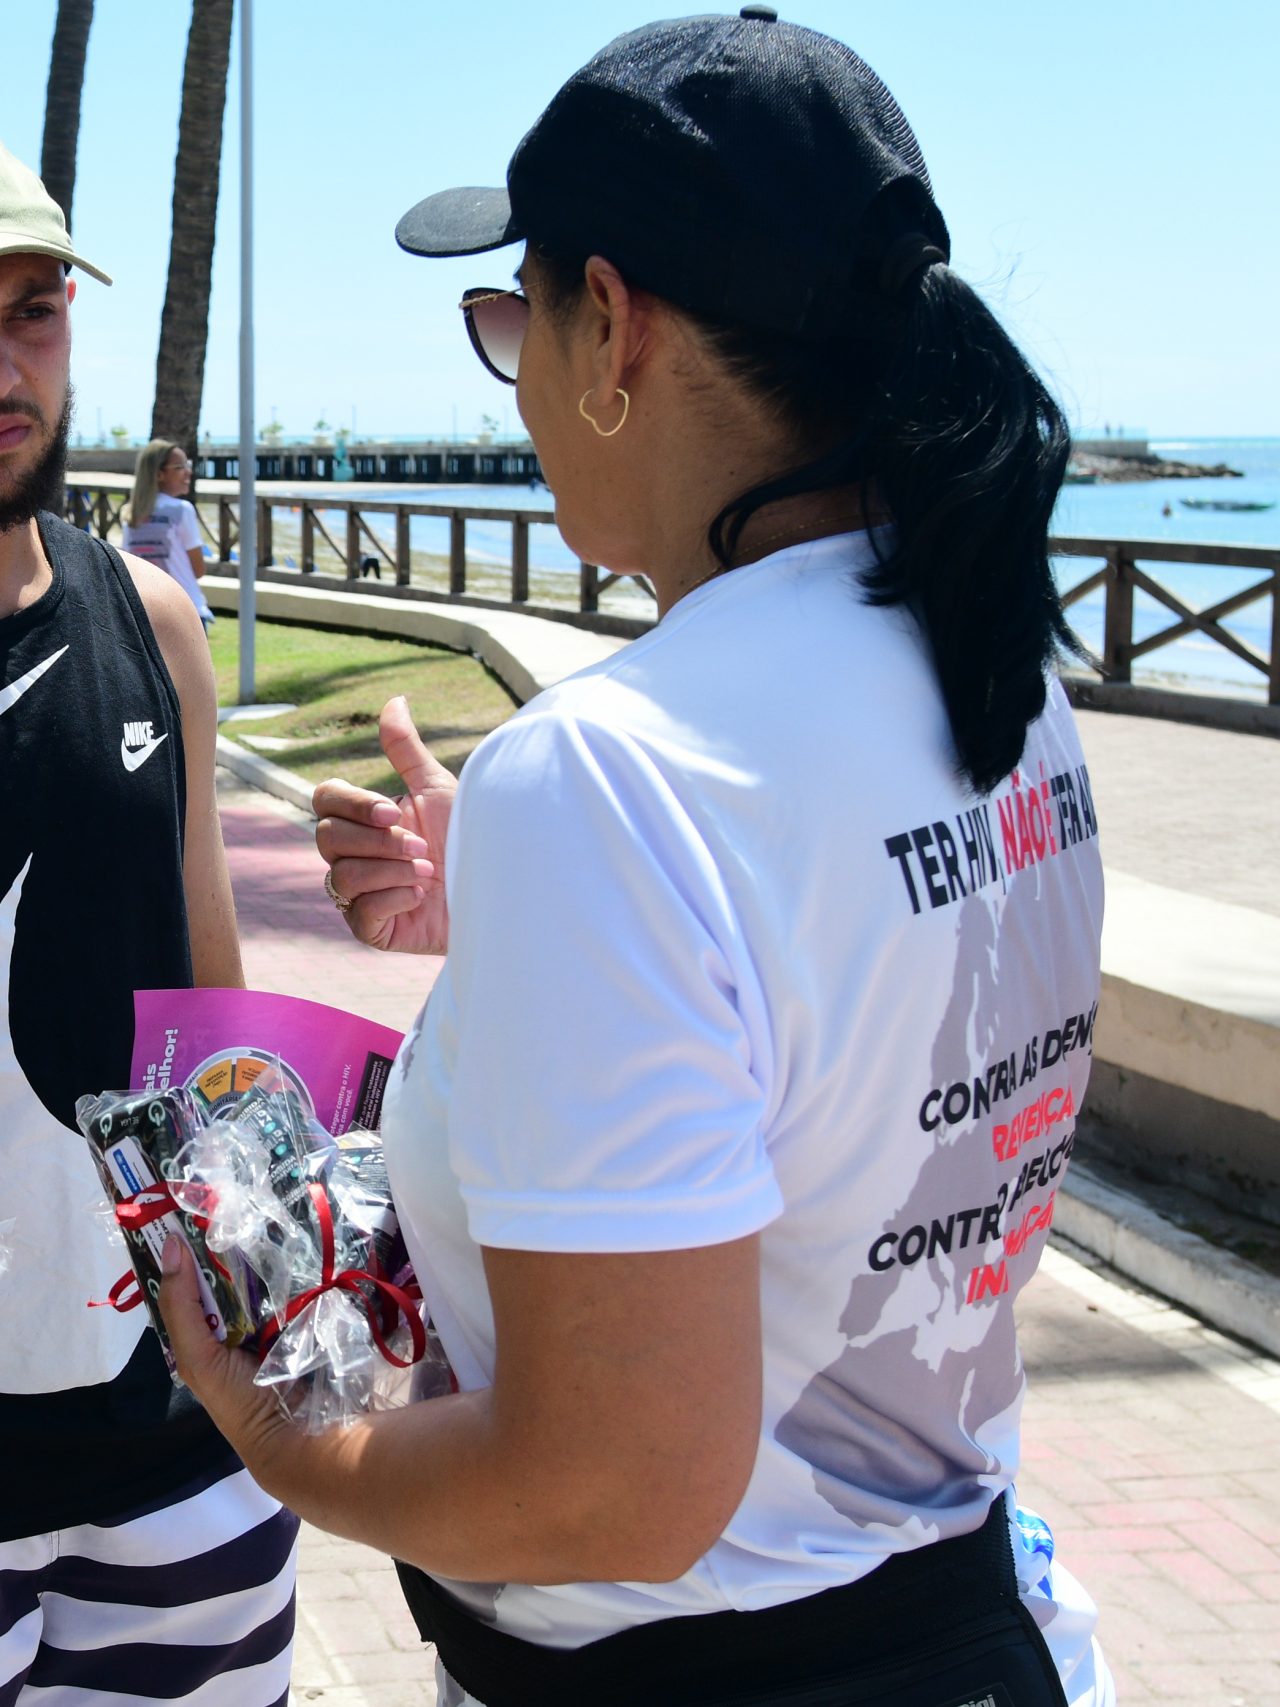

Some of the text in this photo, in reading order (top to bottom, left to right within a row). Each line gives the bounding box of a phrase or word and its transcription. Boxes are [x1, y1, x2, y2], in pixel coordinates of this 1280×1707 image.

[123, 721, 154, 747] NIKE
[884, 820, 967, 915] TER
[996, 768, 1046, 875] NÃO
[1049, 771, 1084, 851] TER
[336, 1086, 347, 1110] contra
[919, 1051, 1017, 1132] CONTRA
[1019, 1035, 1038, 1088] AS
[868, 1203, 1002, 1272] CONTR
